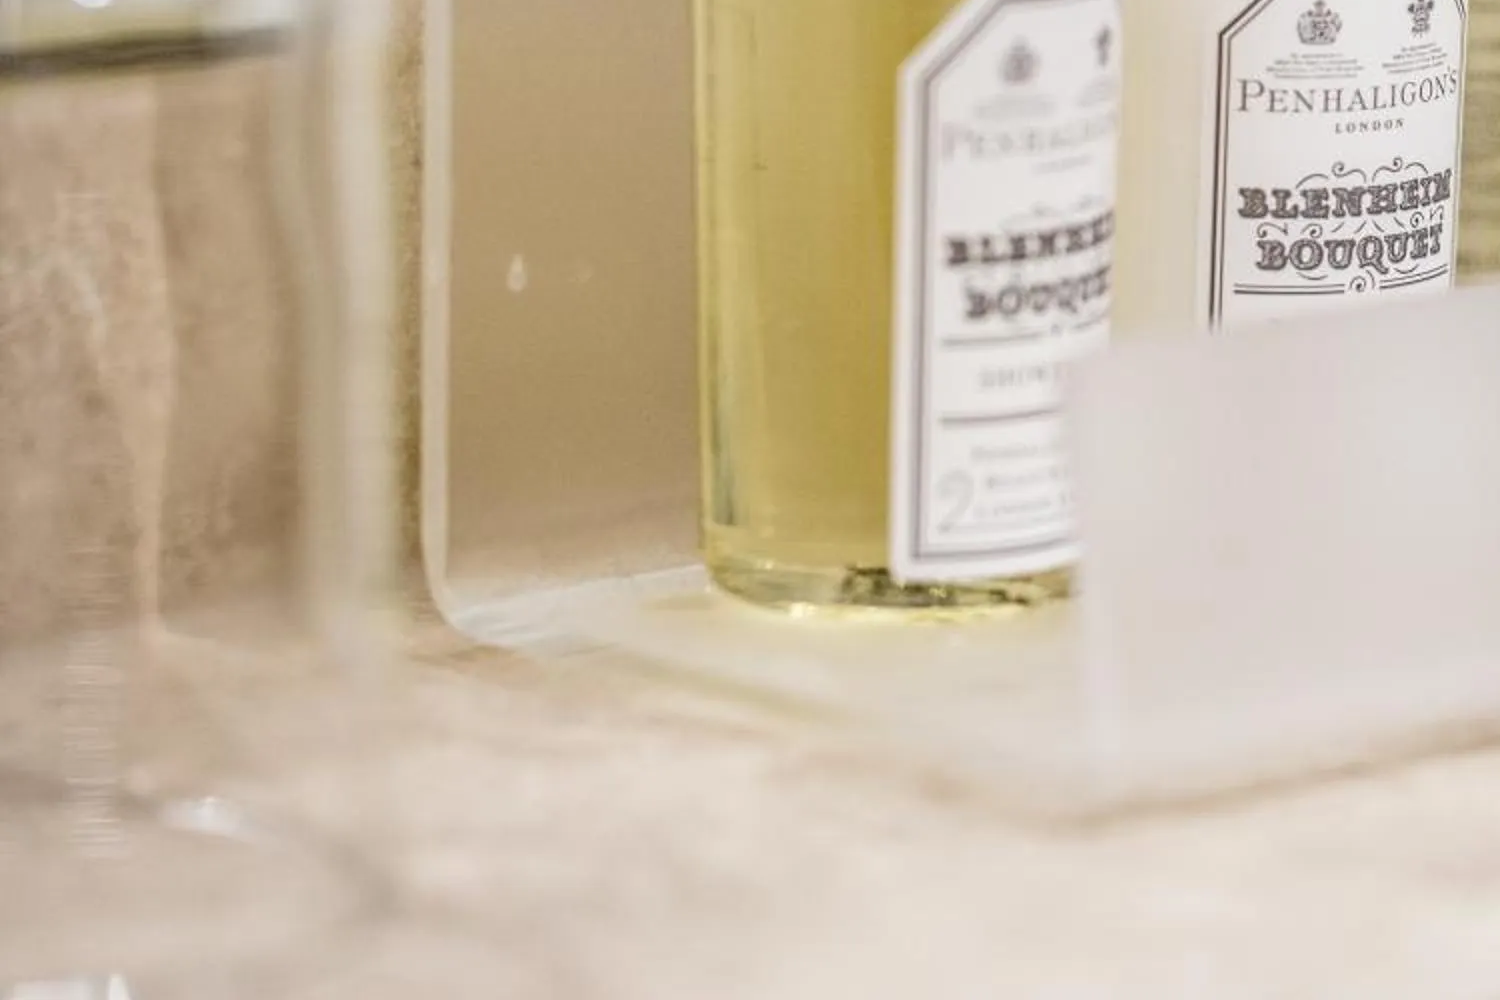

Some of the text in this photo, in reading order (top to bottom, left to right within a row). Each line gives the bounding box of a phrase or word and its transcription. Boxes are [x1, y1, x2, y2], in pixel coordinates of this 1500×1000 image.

[1236, 66, 1457, 113] PENHALIGON'S
[1335, 118, 1405, 134] LONDON
[1238, 168, 1452, 219] BLENHEIM
[1256, 223, 1443, 275] BOUQUET
